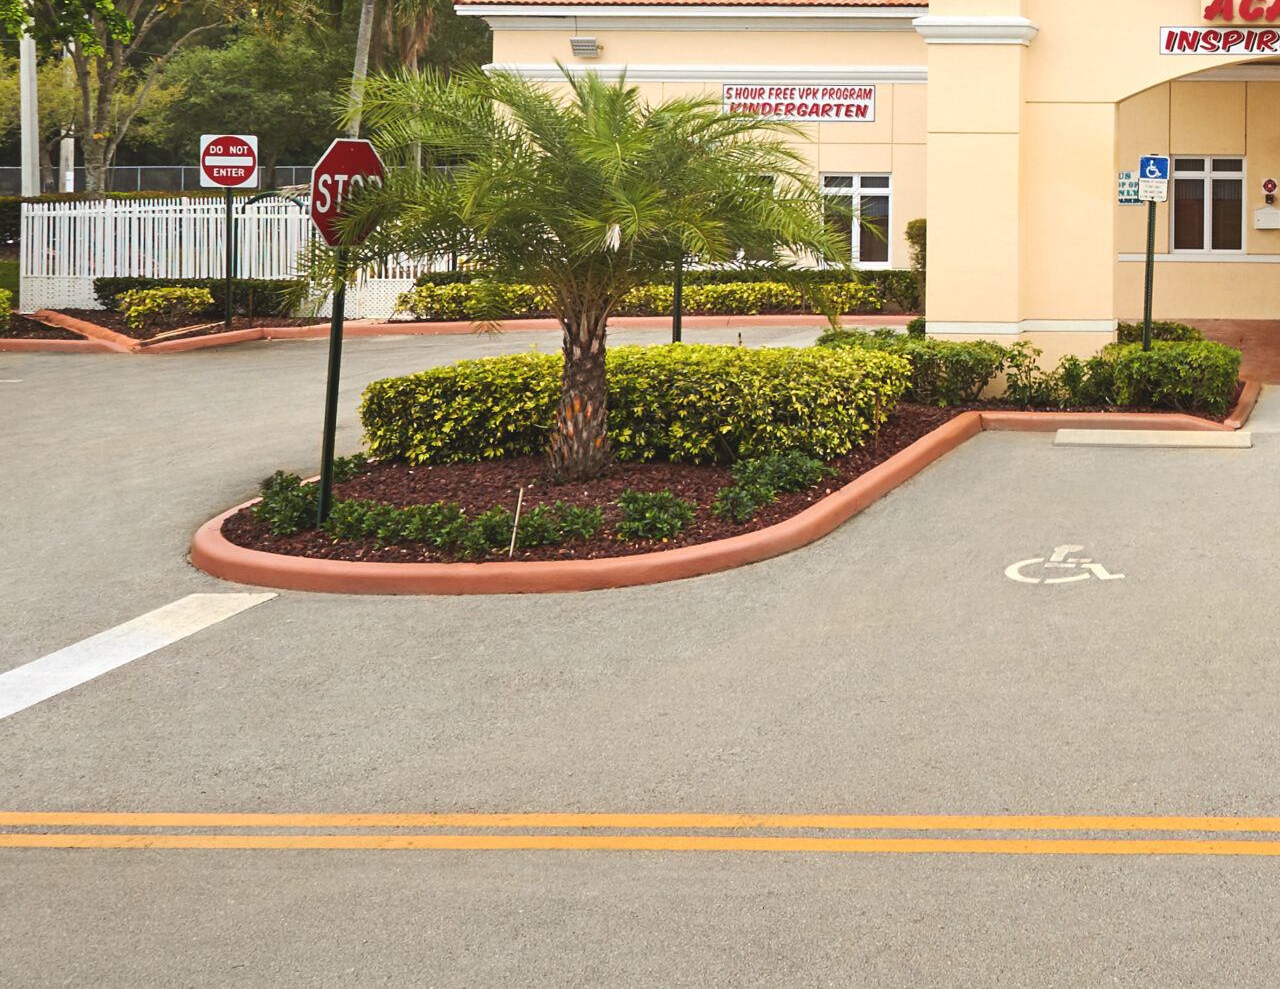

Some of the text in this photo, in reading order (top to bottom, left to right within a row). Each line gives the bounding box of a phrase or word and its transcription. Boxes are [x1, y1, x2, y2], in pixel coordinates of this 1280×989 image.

[735, 87, 765, 100] HOUR
[768, 87, 795, 100] FREE
[798, 87, 819, 100] VPK
[821, 87, 873, 101] PROGRAM
[729, 102, 869, 118] KINDERGARTEN
[209, 145, 249, 154] DO NOT
[213, 168, 245, 177] ENTER
